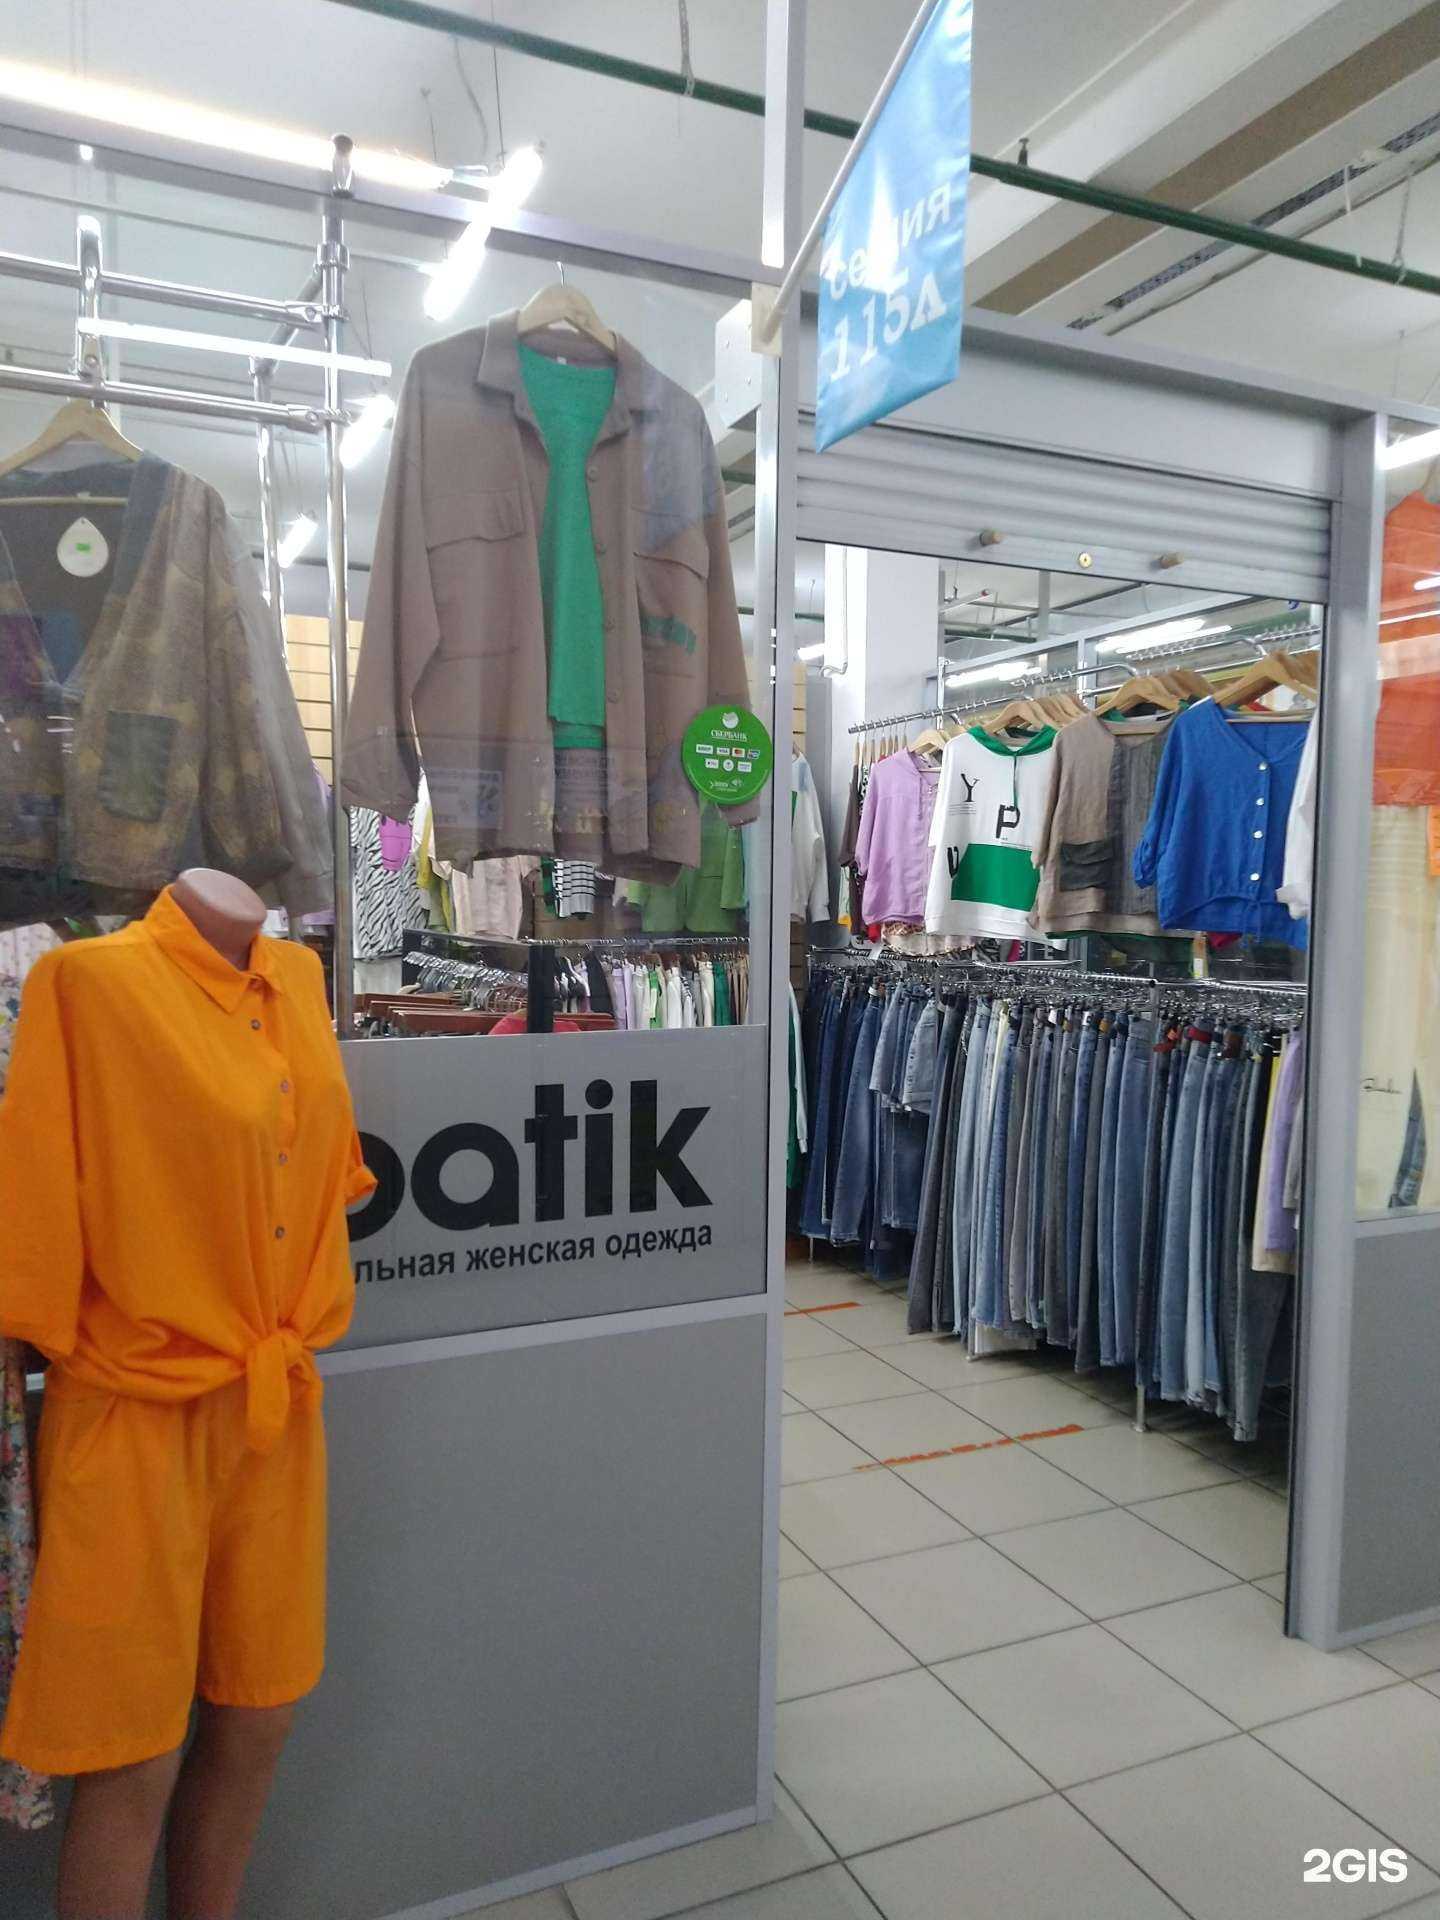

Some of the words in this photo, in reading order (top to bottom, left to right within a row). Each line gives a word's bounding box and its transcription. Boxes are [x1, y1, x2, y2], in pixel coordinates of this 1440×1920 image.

[995, 804, 1020, 838] P
[355, 1251, 455, 1284] льная
[466, 1236, 595, 1272] женская
[605, 1224, 713, 1260] одежда
